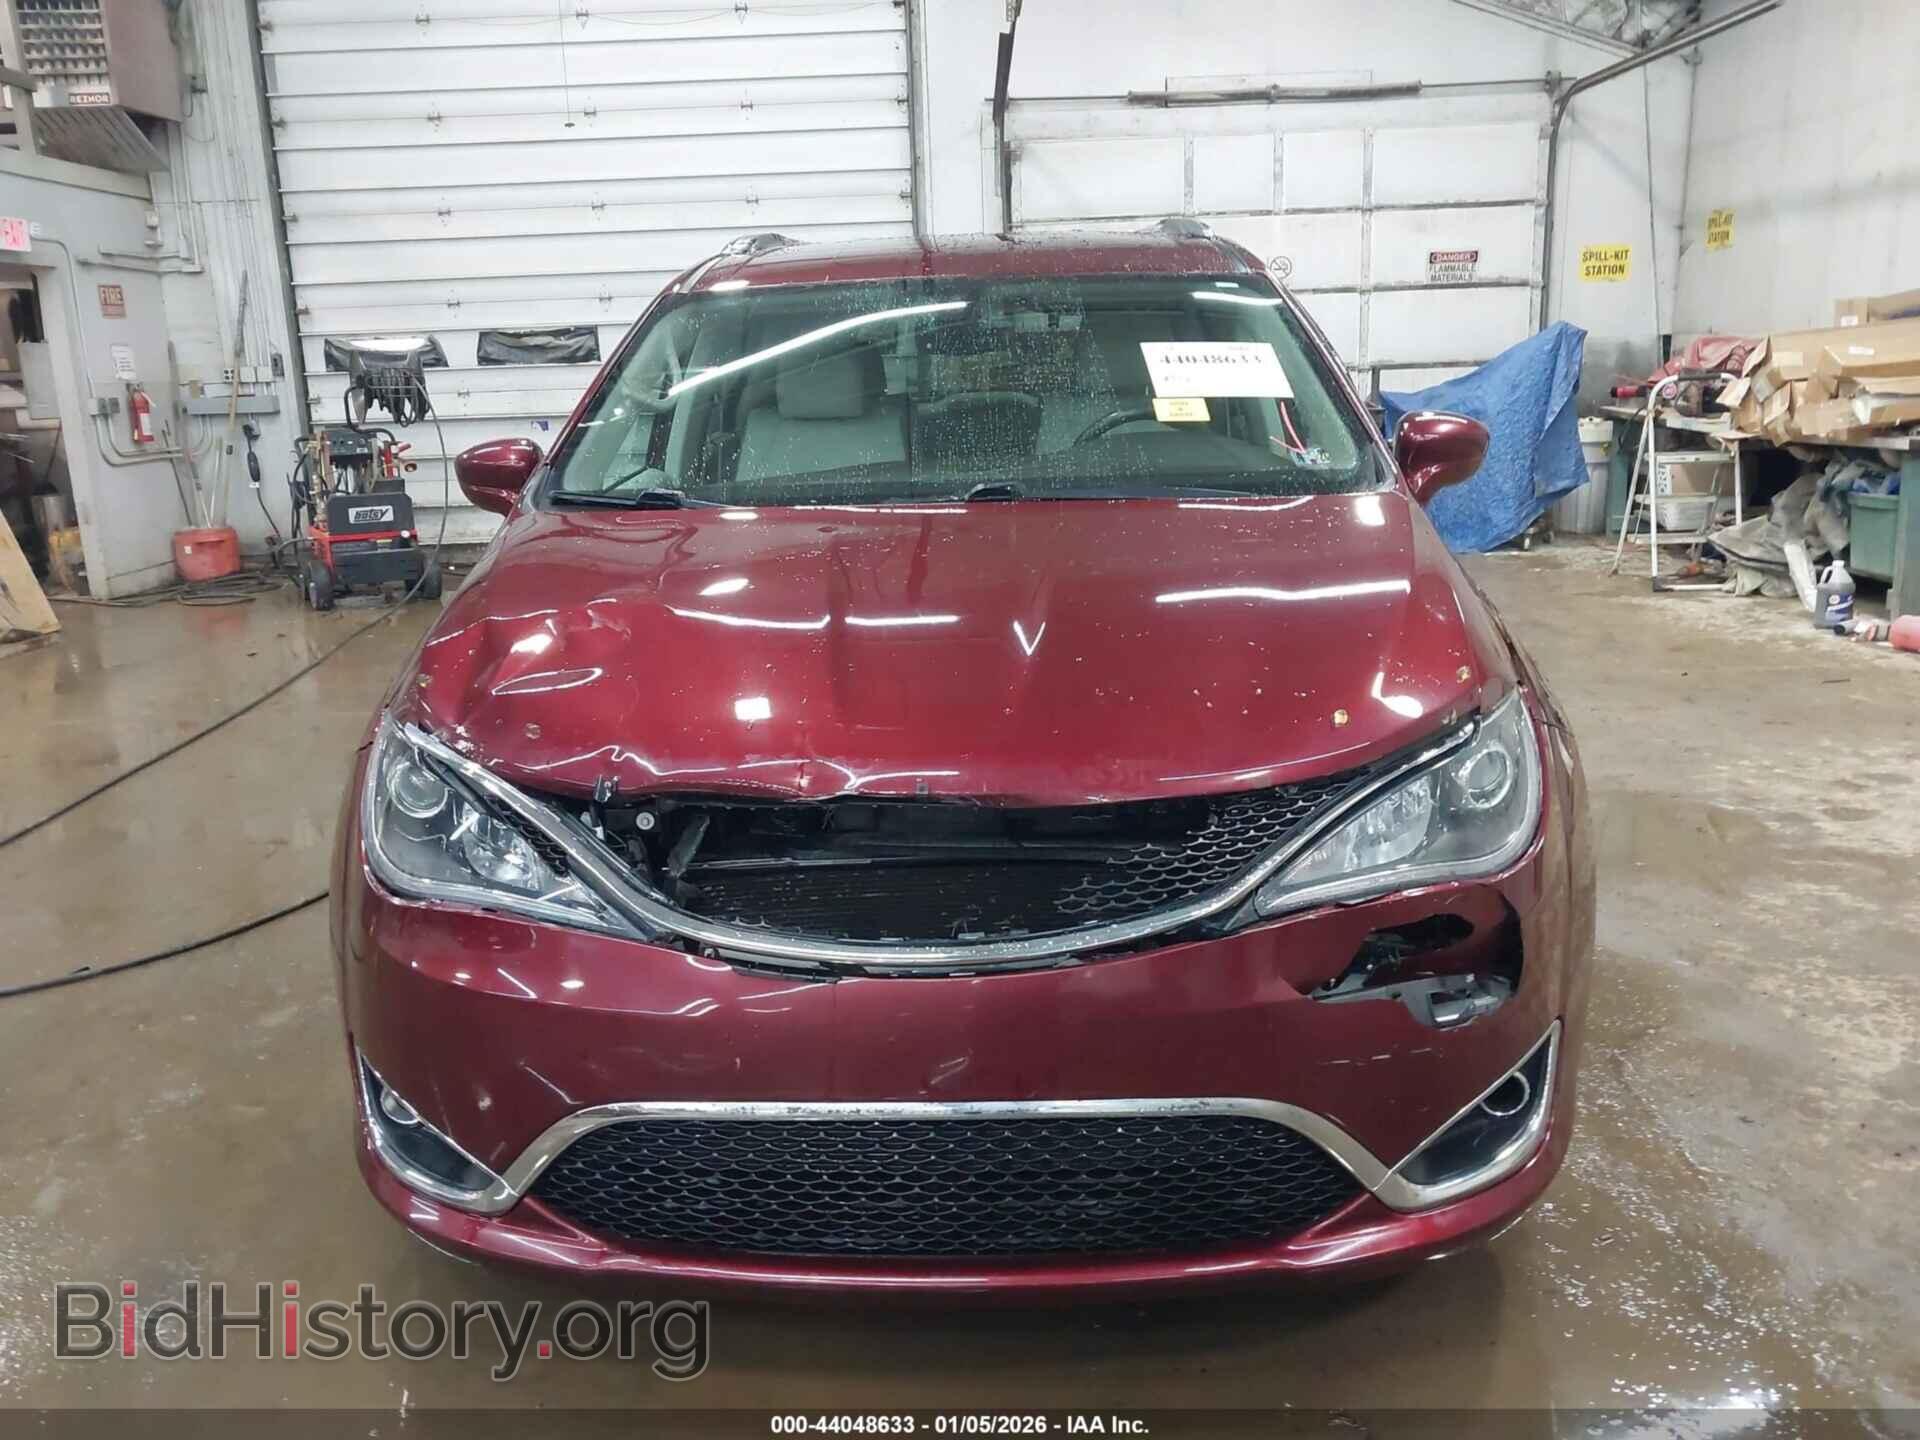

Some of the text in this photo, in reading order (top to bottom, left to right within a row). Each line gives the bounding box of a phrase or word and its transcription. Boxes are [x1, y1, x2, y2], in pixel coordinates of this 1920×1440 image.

[1436, 253, 1471, 262] DANGER
[1582, 249, 1629, 262] SPILL-KIT
[1429, 263, 1476, 273] FLAMMABLE
[1585, 264, 1625, 276] STATION
[1430, 272, 1472, 282] MATERIALS
[100, 286, 123, 305] FIRE
